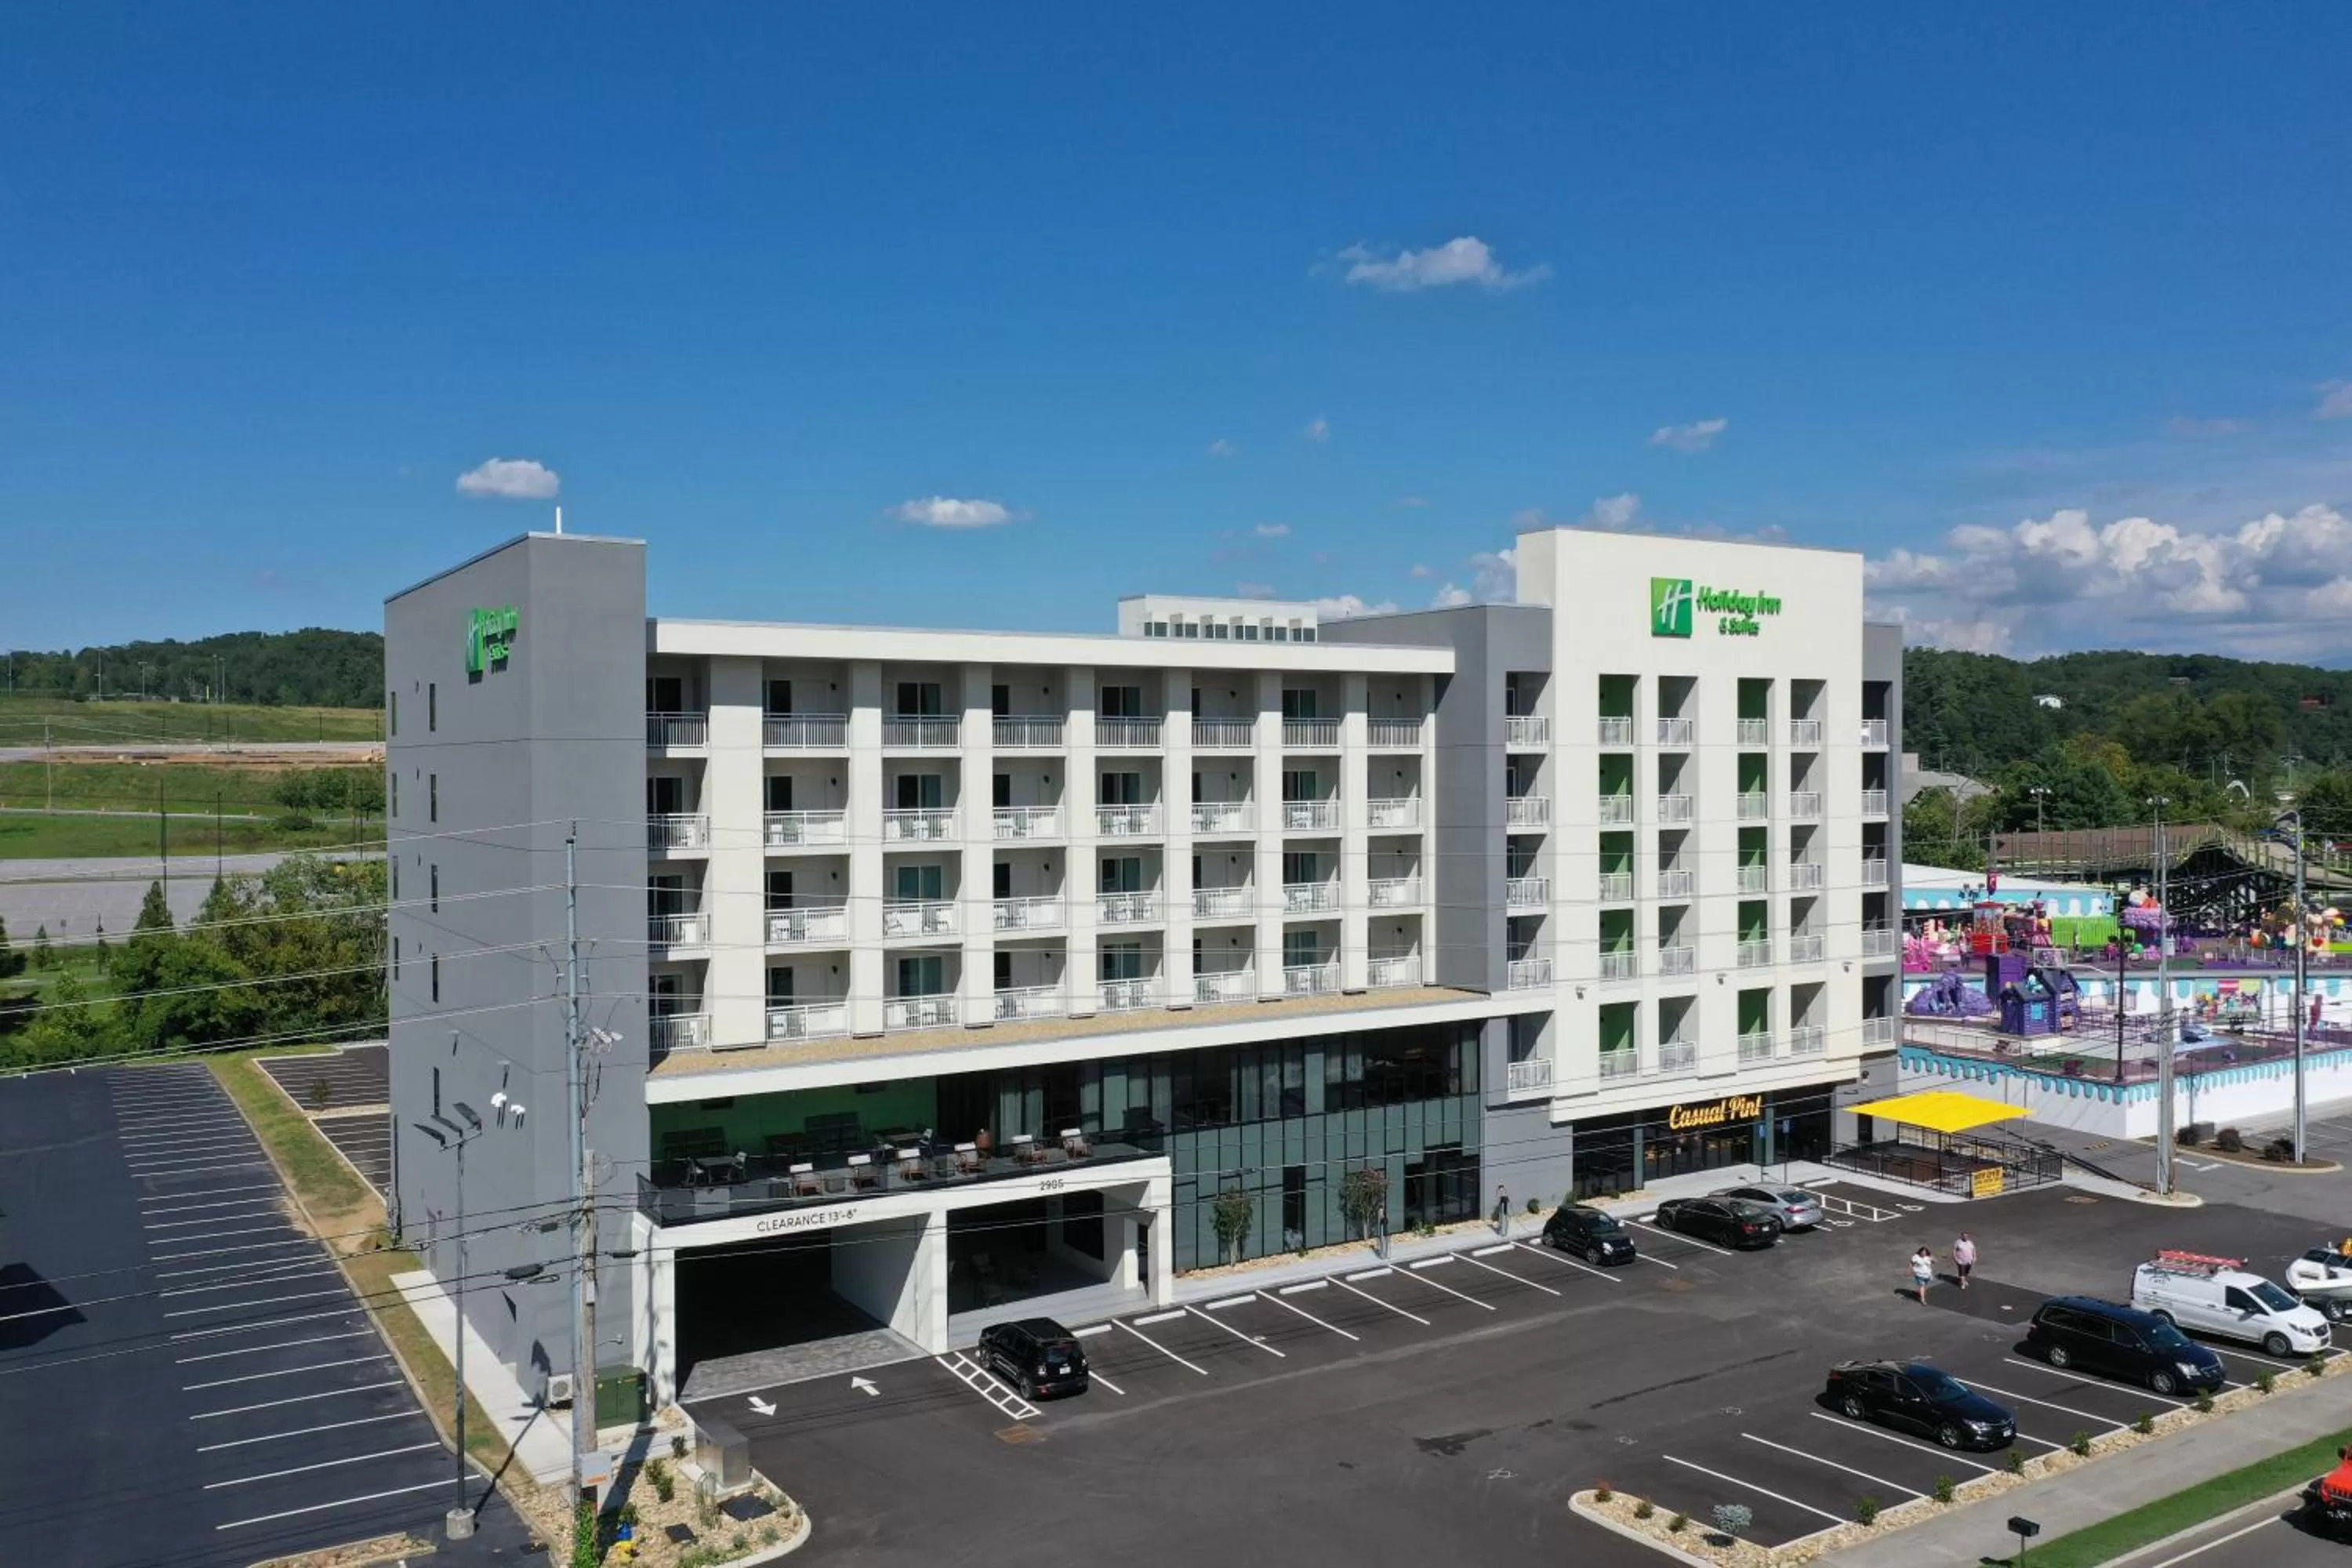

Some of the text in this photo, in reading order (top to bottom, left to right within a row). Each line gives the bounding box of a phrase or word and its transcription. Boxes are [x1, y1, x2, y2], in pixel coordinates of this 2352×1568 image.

[1697, 586, 1781, 619] Holiday Inn
[1669, 1100, 1726, 1129] Casual
[757, 1213, 826, 1232] CLEARANCE
